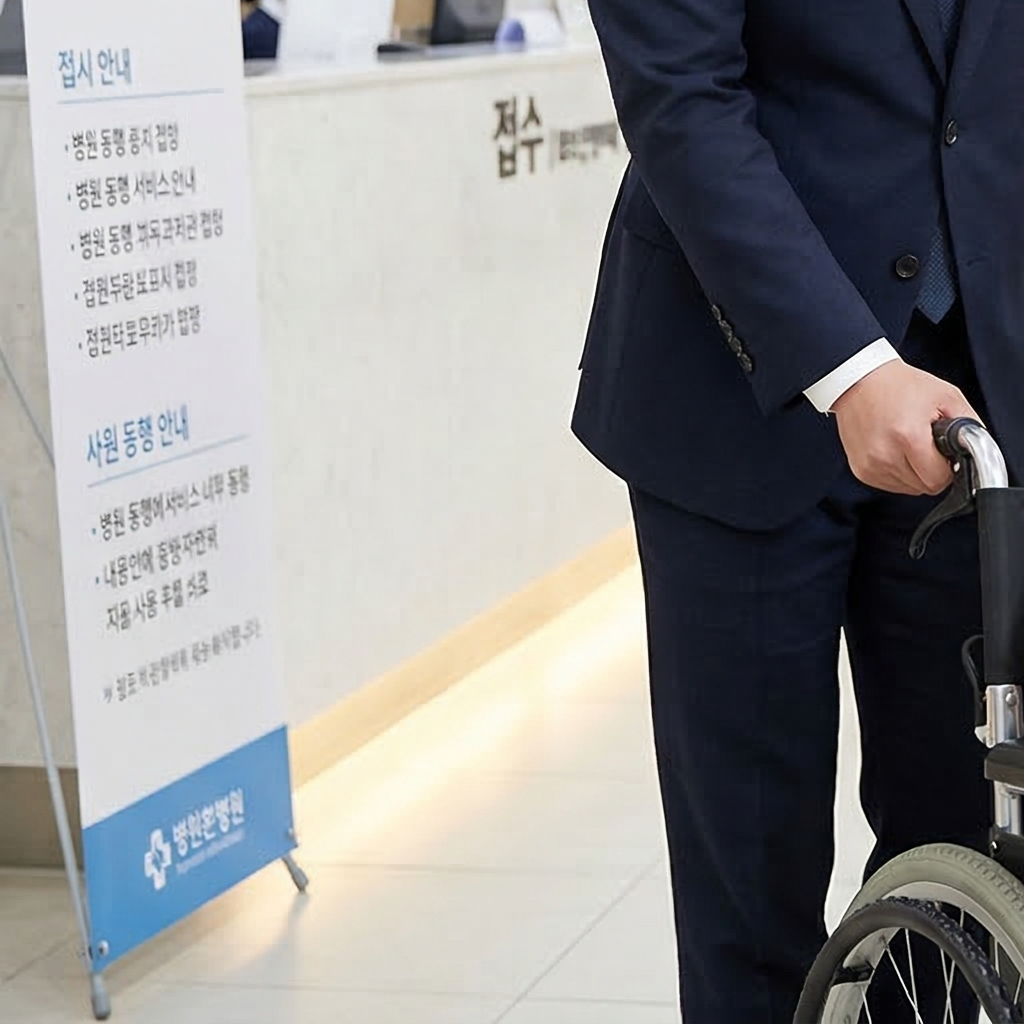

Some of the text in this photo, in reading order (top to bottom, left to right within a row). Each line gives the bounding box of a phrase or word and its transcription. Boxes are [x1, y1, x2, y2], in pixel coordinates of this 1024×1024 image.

[58, 47, 131, 89] 접시 안내
[72, 129, 97, 161] 병원
[101, 128, 126, 157] 동행
[493, 94, 544, 178] 접수
[76, 176, 102, 210] 병원
[105, 173, 130, 206] 동행
[79, 227, 105, 260] 병원
[109, 225, 133, 254] 동행
[87, 404, 189, 468] 사원 동행 안내
[100, 507, 125, 541] 병원
